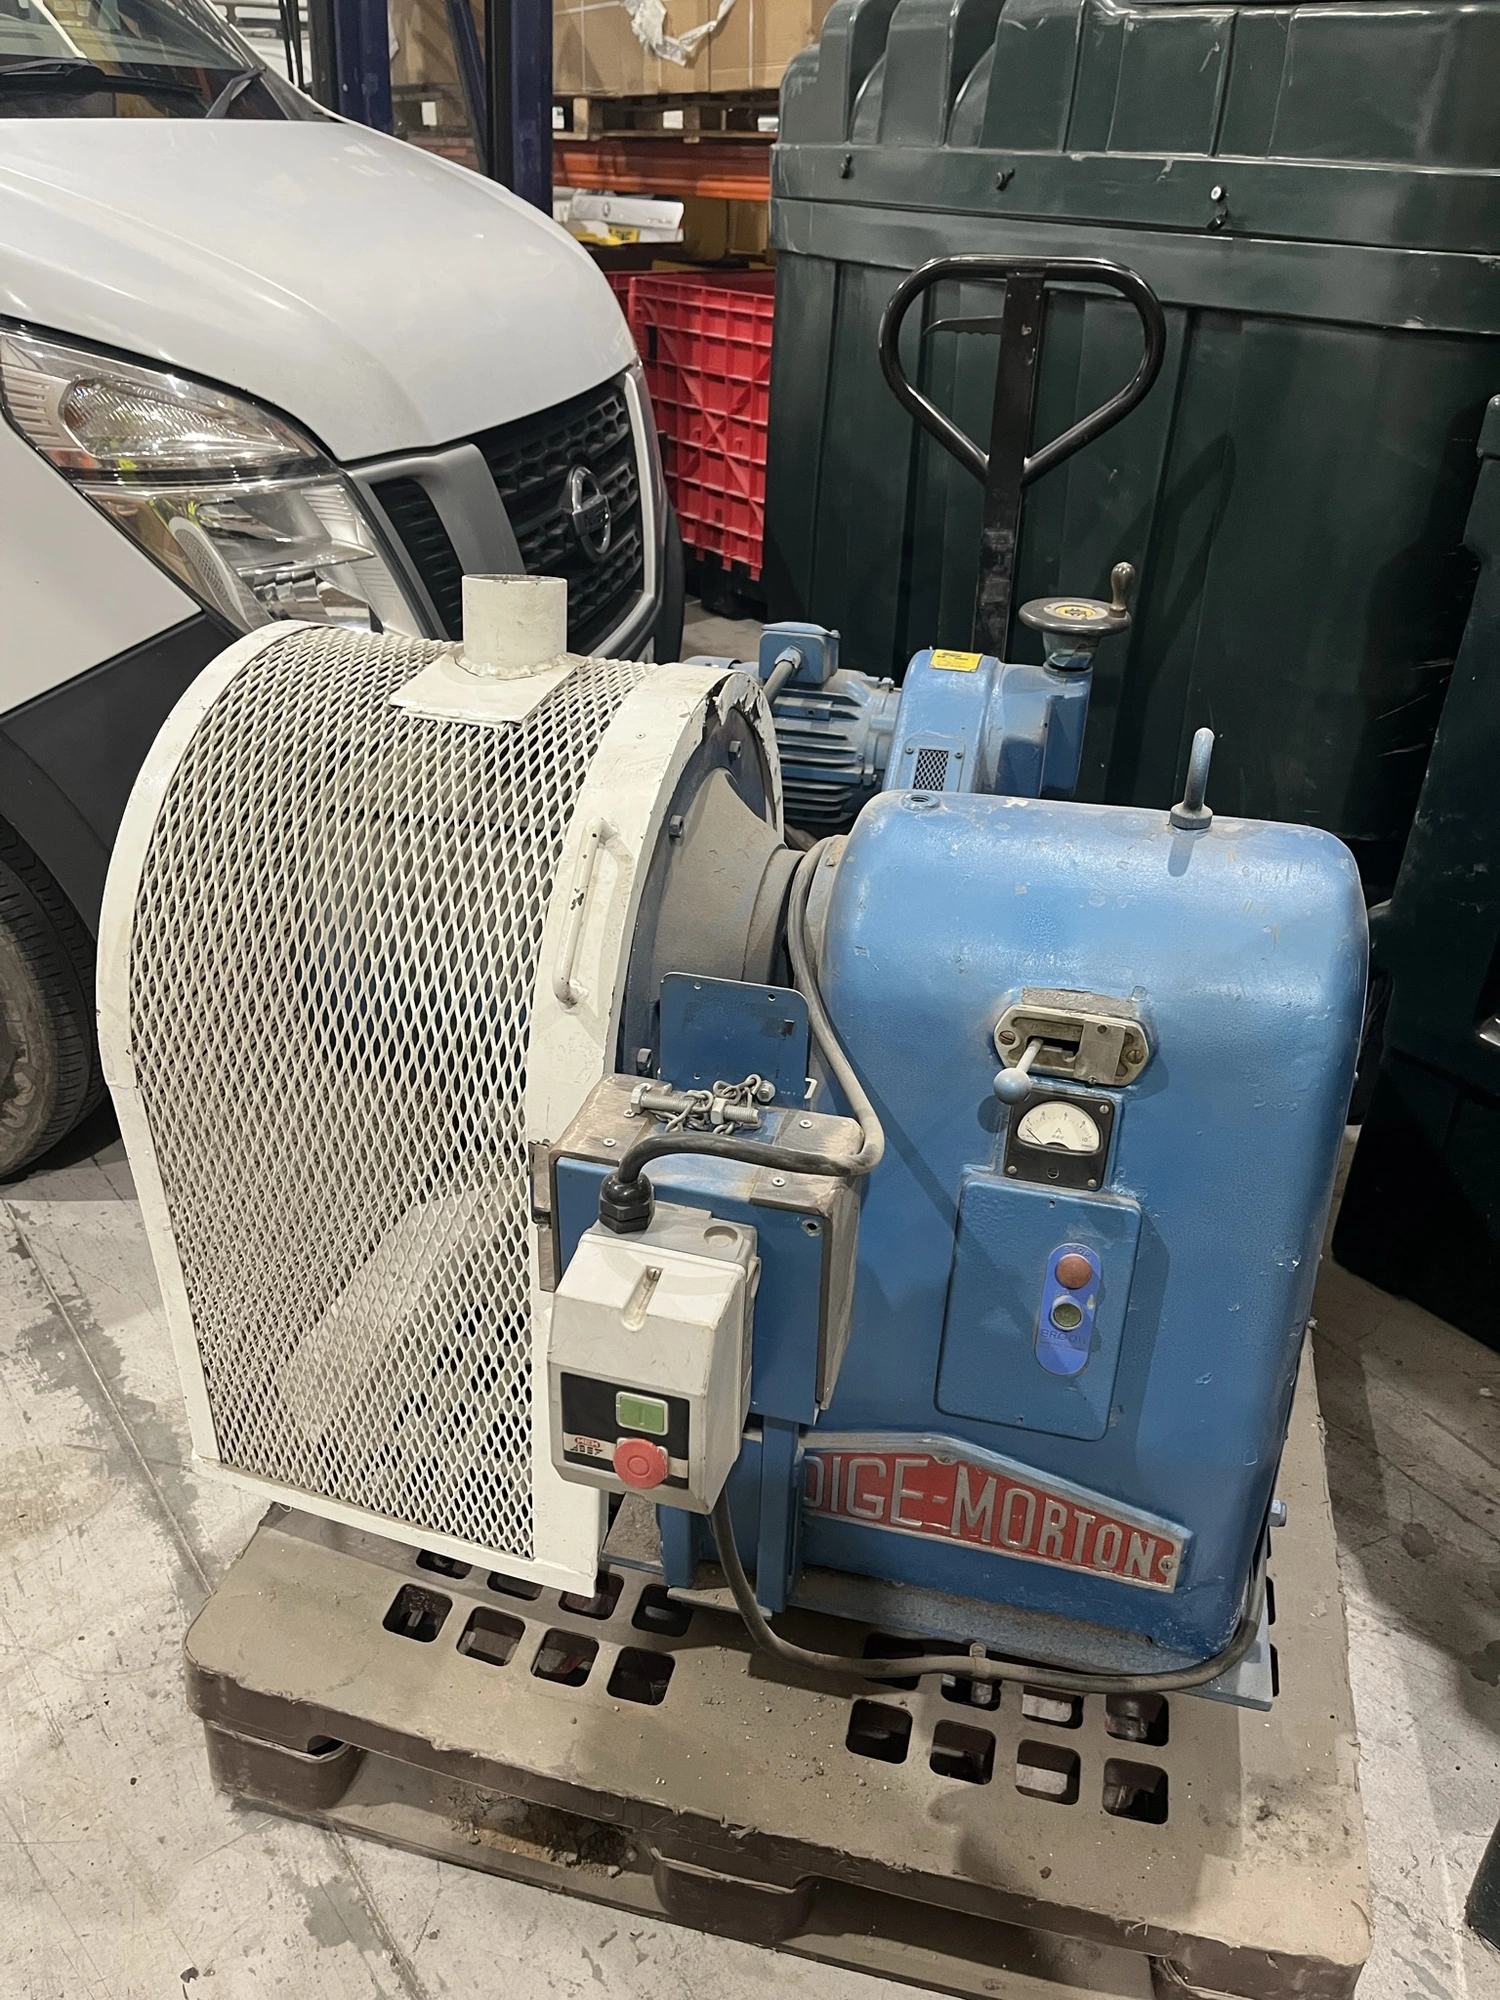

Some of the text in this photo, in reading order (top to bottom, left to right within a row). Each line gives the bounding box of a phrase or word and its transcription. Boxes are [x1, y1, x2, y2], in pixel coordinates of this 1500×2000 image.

[1054, 1127, 1062, 1135] A
[1063, 1245, 1091, 1257] STOP
[576, 1436, 600, 1448] MEM
